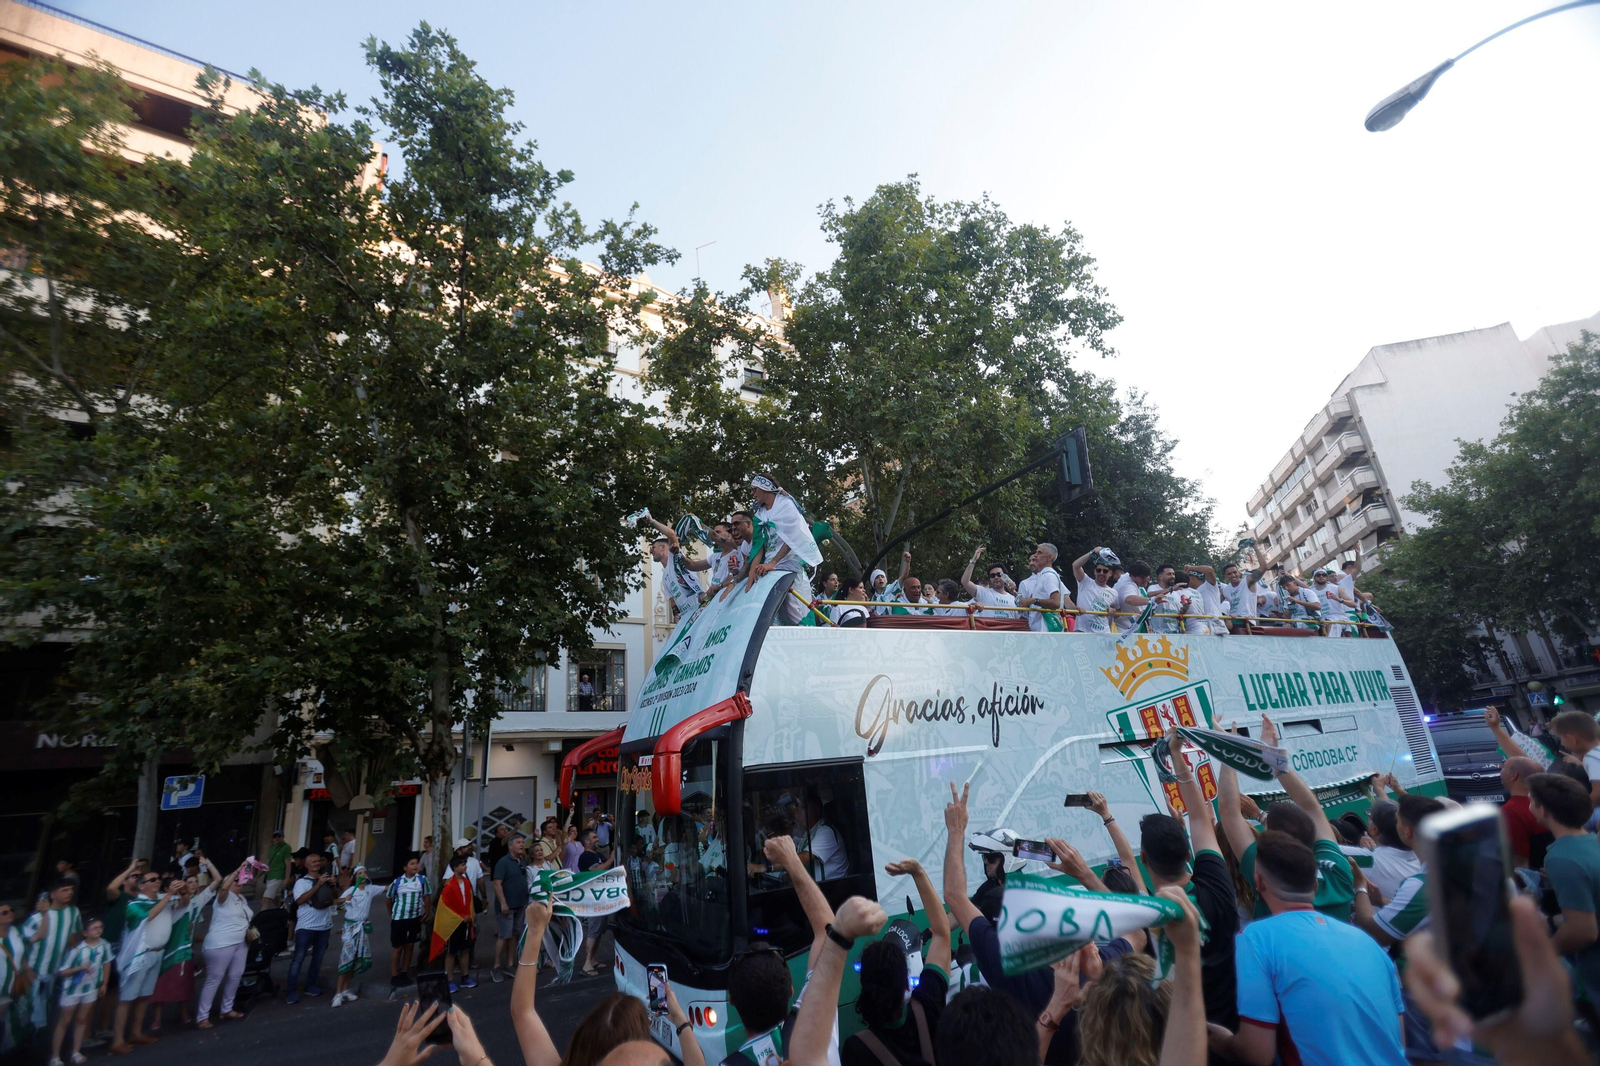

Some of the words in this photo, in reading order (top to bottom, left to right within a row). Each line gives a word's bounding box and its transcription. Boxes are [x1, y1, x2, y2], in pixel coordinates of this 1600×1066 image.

[1238, 671, 1312, 711] LUCHAR
[1309, 671, 1353, 705] PARA
[1353, 669, 1393, 702] VIVIR
[977, 682, 1045, 748] afición
[1343, 745, 1359, 762] CF
[897, 927, 912, 950] LOCAL
